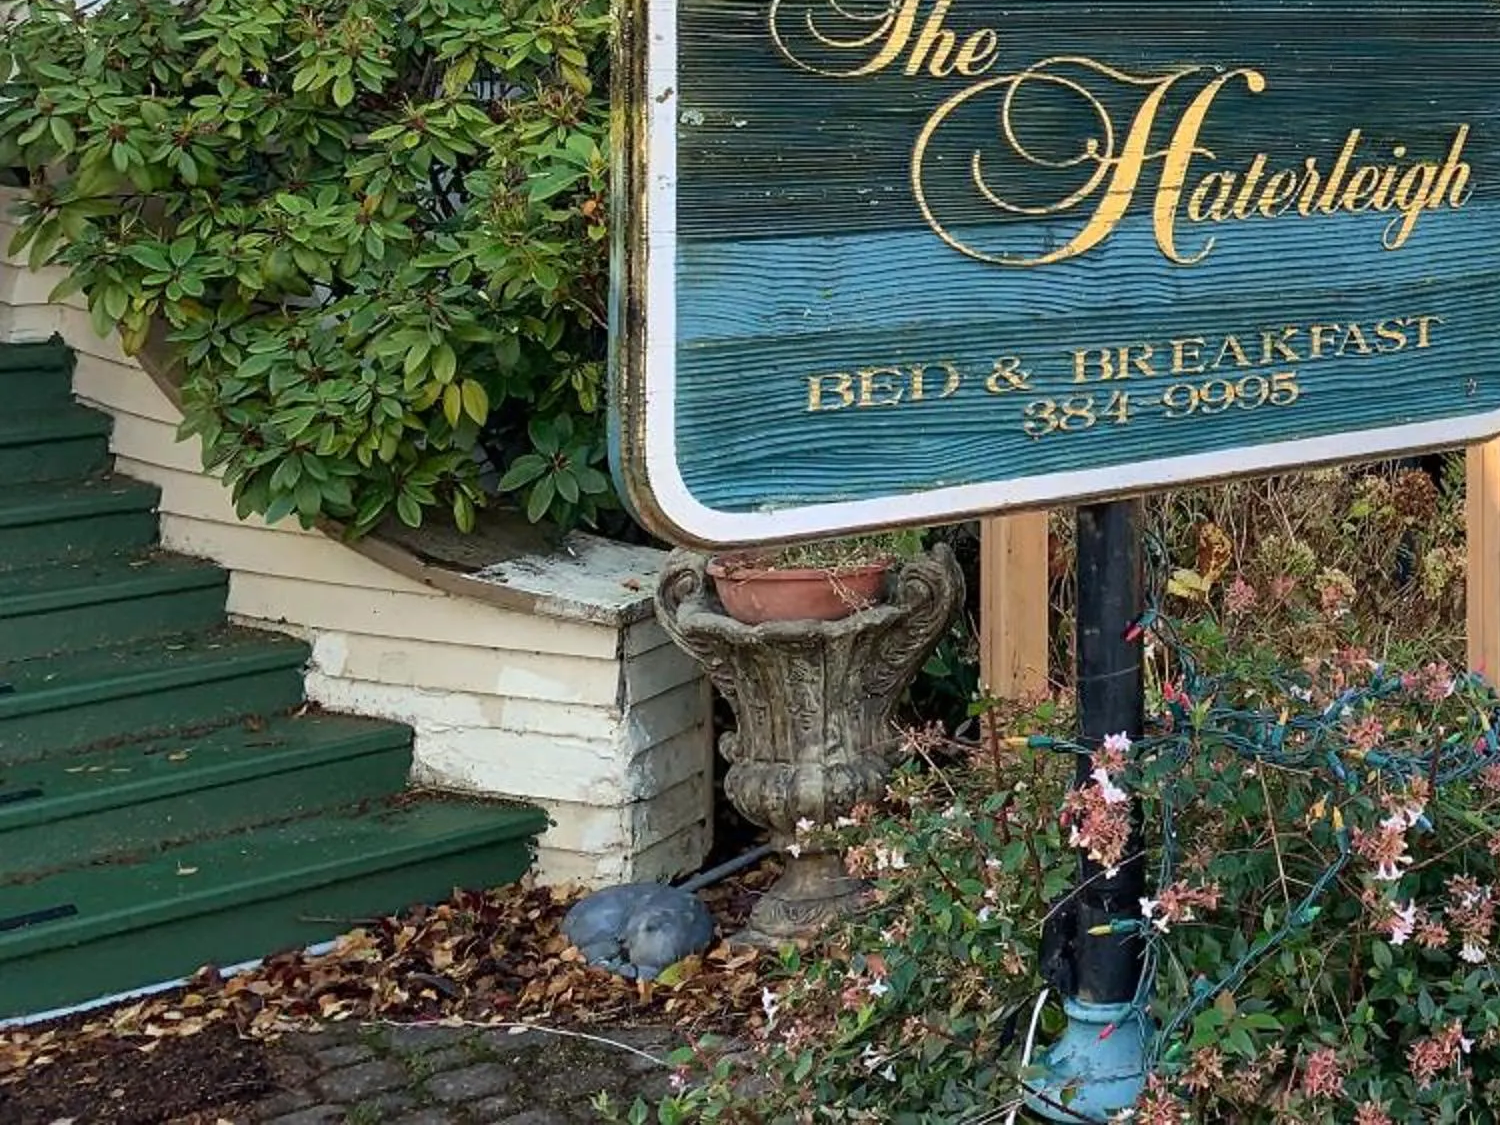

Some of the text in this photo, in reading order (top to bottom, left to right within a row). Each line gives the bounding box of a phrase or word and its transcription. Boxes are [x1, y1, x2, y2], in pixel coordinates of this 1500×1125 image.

[910, 55, 1474, 267] Haterleigh
[805, 314, 1446, 412] BED & BREAKFAST
[1022, 371, 1300, 440] 384-9995
